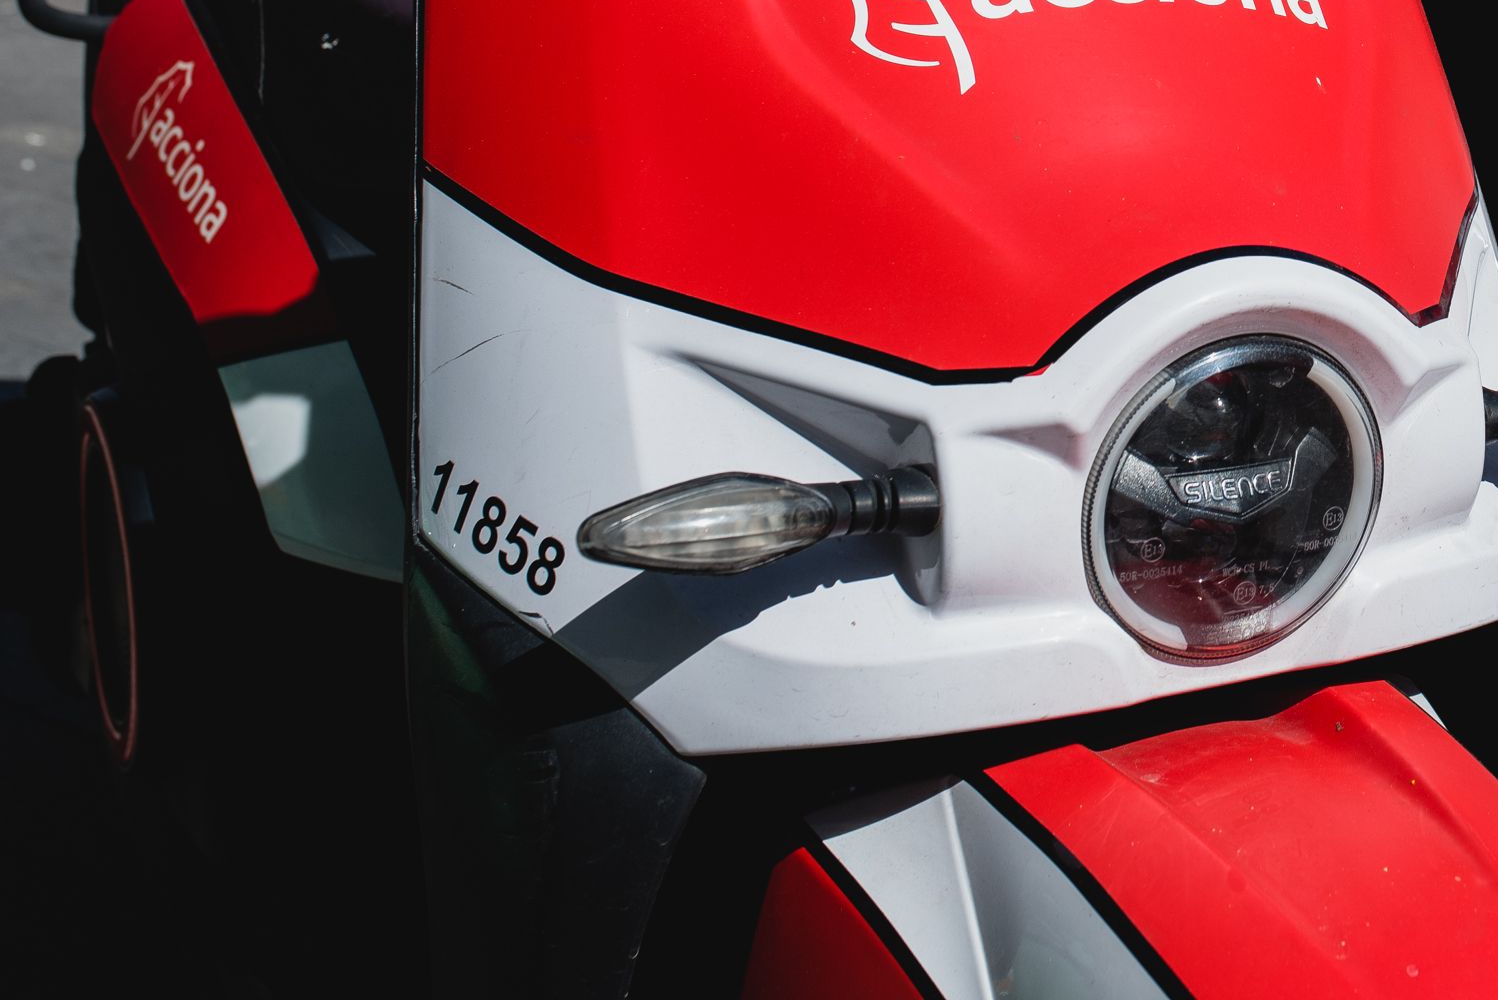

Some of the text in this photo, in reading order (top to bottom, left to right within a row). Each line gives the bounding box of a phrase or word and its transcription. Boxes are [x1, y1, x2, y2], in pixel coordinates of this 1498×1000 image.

[150, 107, 228, 244] acciona
[431, 460, 565, 596] 11858
[1184, 470, 1283, 504] SILENCE
